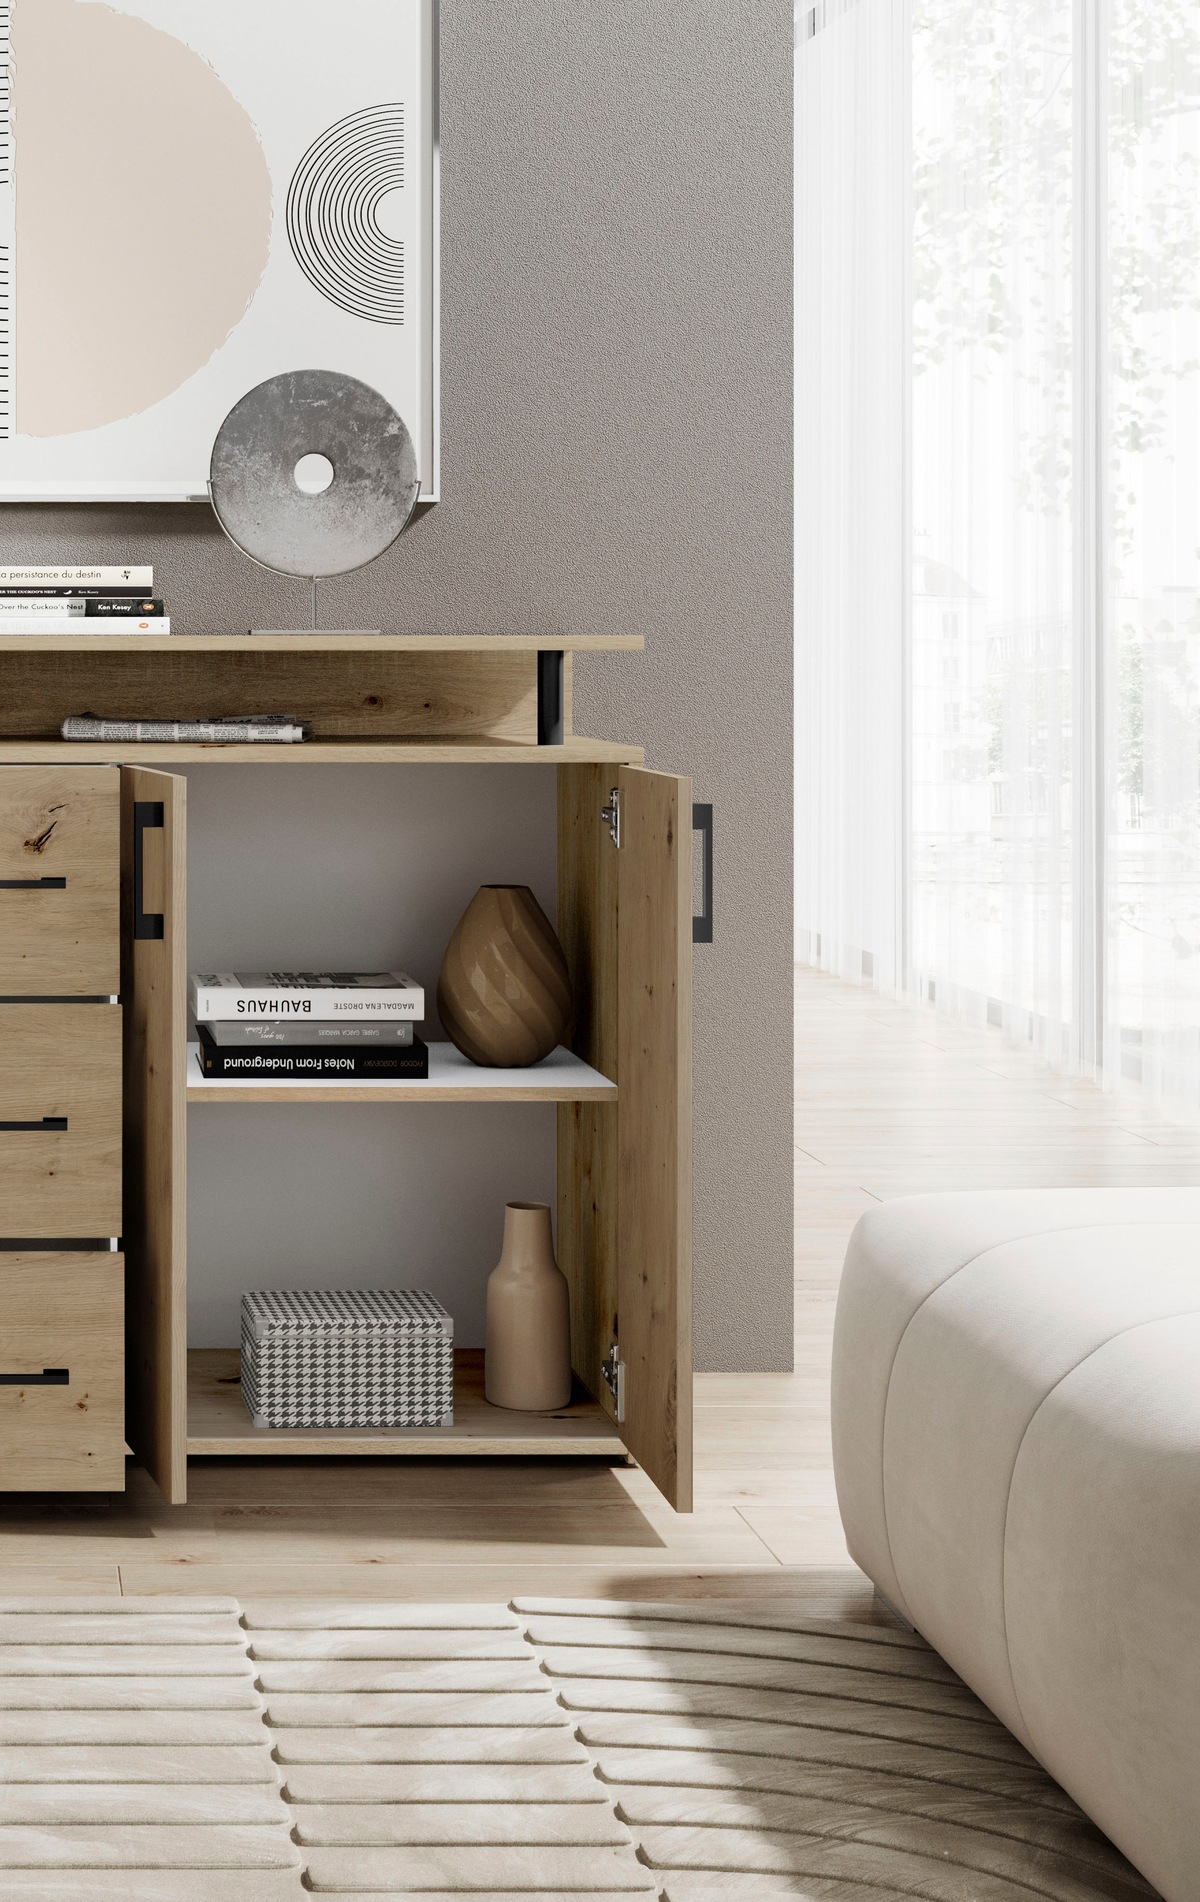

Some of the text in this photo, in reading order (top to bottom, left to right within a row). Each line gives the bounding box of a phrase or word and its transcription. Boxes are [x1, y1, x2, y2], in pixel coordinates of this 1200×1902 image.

[10, 570, 59, 580] persistance
[61, 570, 73, 579] du
[75, 570, 102, 579] destin
[66, 603, 84, 611] Nest
[112, 604, 132, 612] Kesey
[237, 1000, 312, 1013] BAUHAUS
[333, 1002, 415, 1010] MAGDALENA DROSTE
[223, 1056, 355, 1070] Notes From Underground
